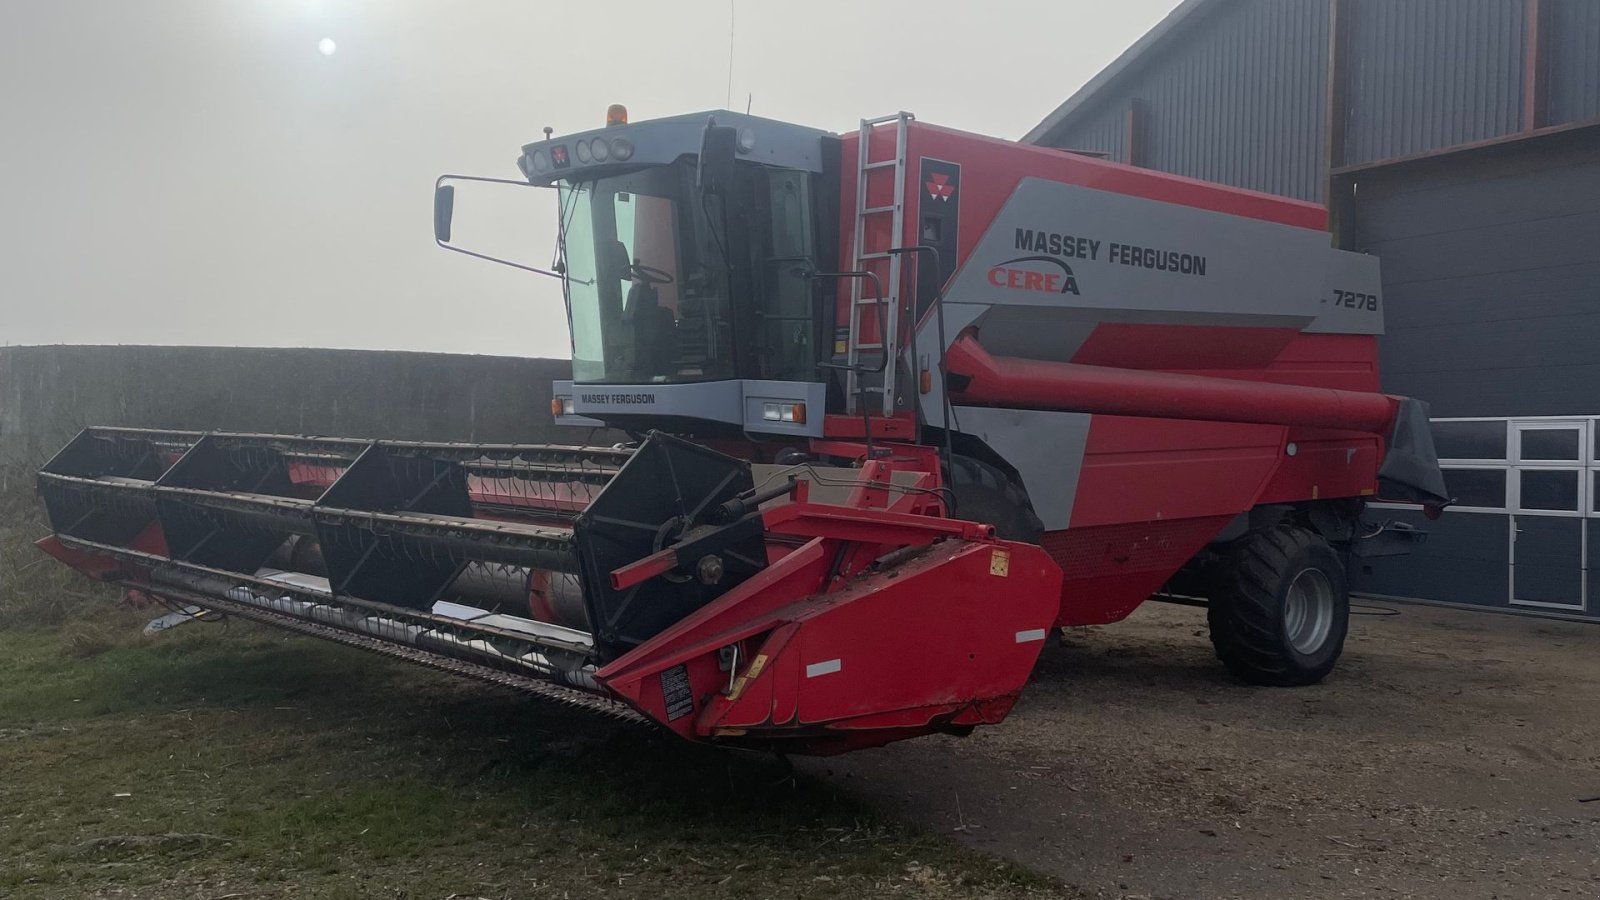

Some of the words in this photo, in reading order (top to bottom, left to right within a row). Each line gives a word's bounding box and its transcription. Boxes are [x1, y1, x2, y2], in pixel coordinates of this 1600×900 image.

[1015, 228, 1101, 260] MASSEY
[1109, 243, 1206, 276] FERGUSON
[987, 267, 1080, 296] CEREA
[1333, 289, 1377, 312] 7278
[581, 393, 610, 404] MASSEY
[611, 393, 655, 405] FERGUSON
